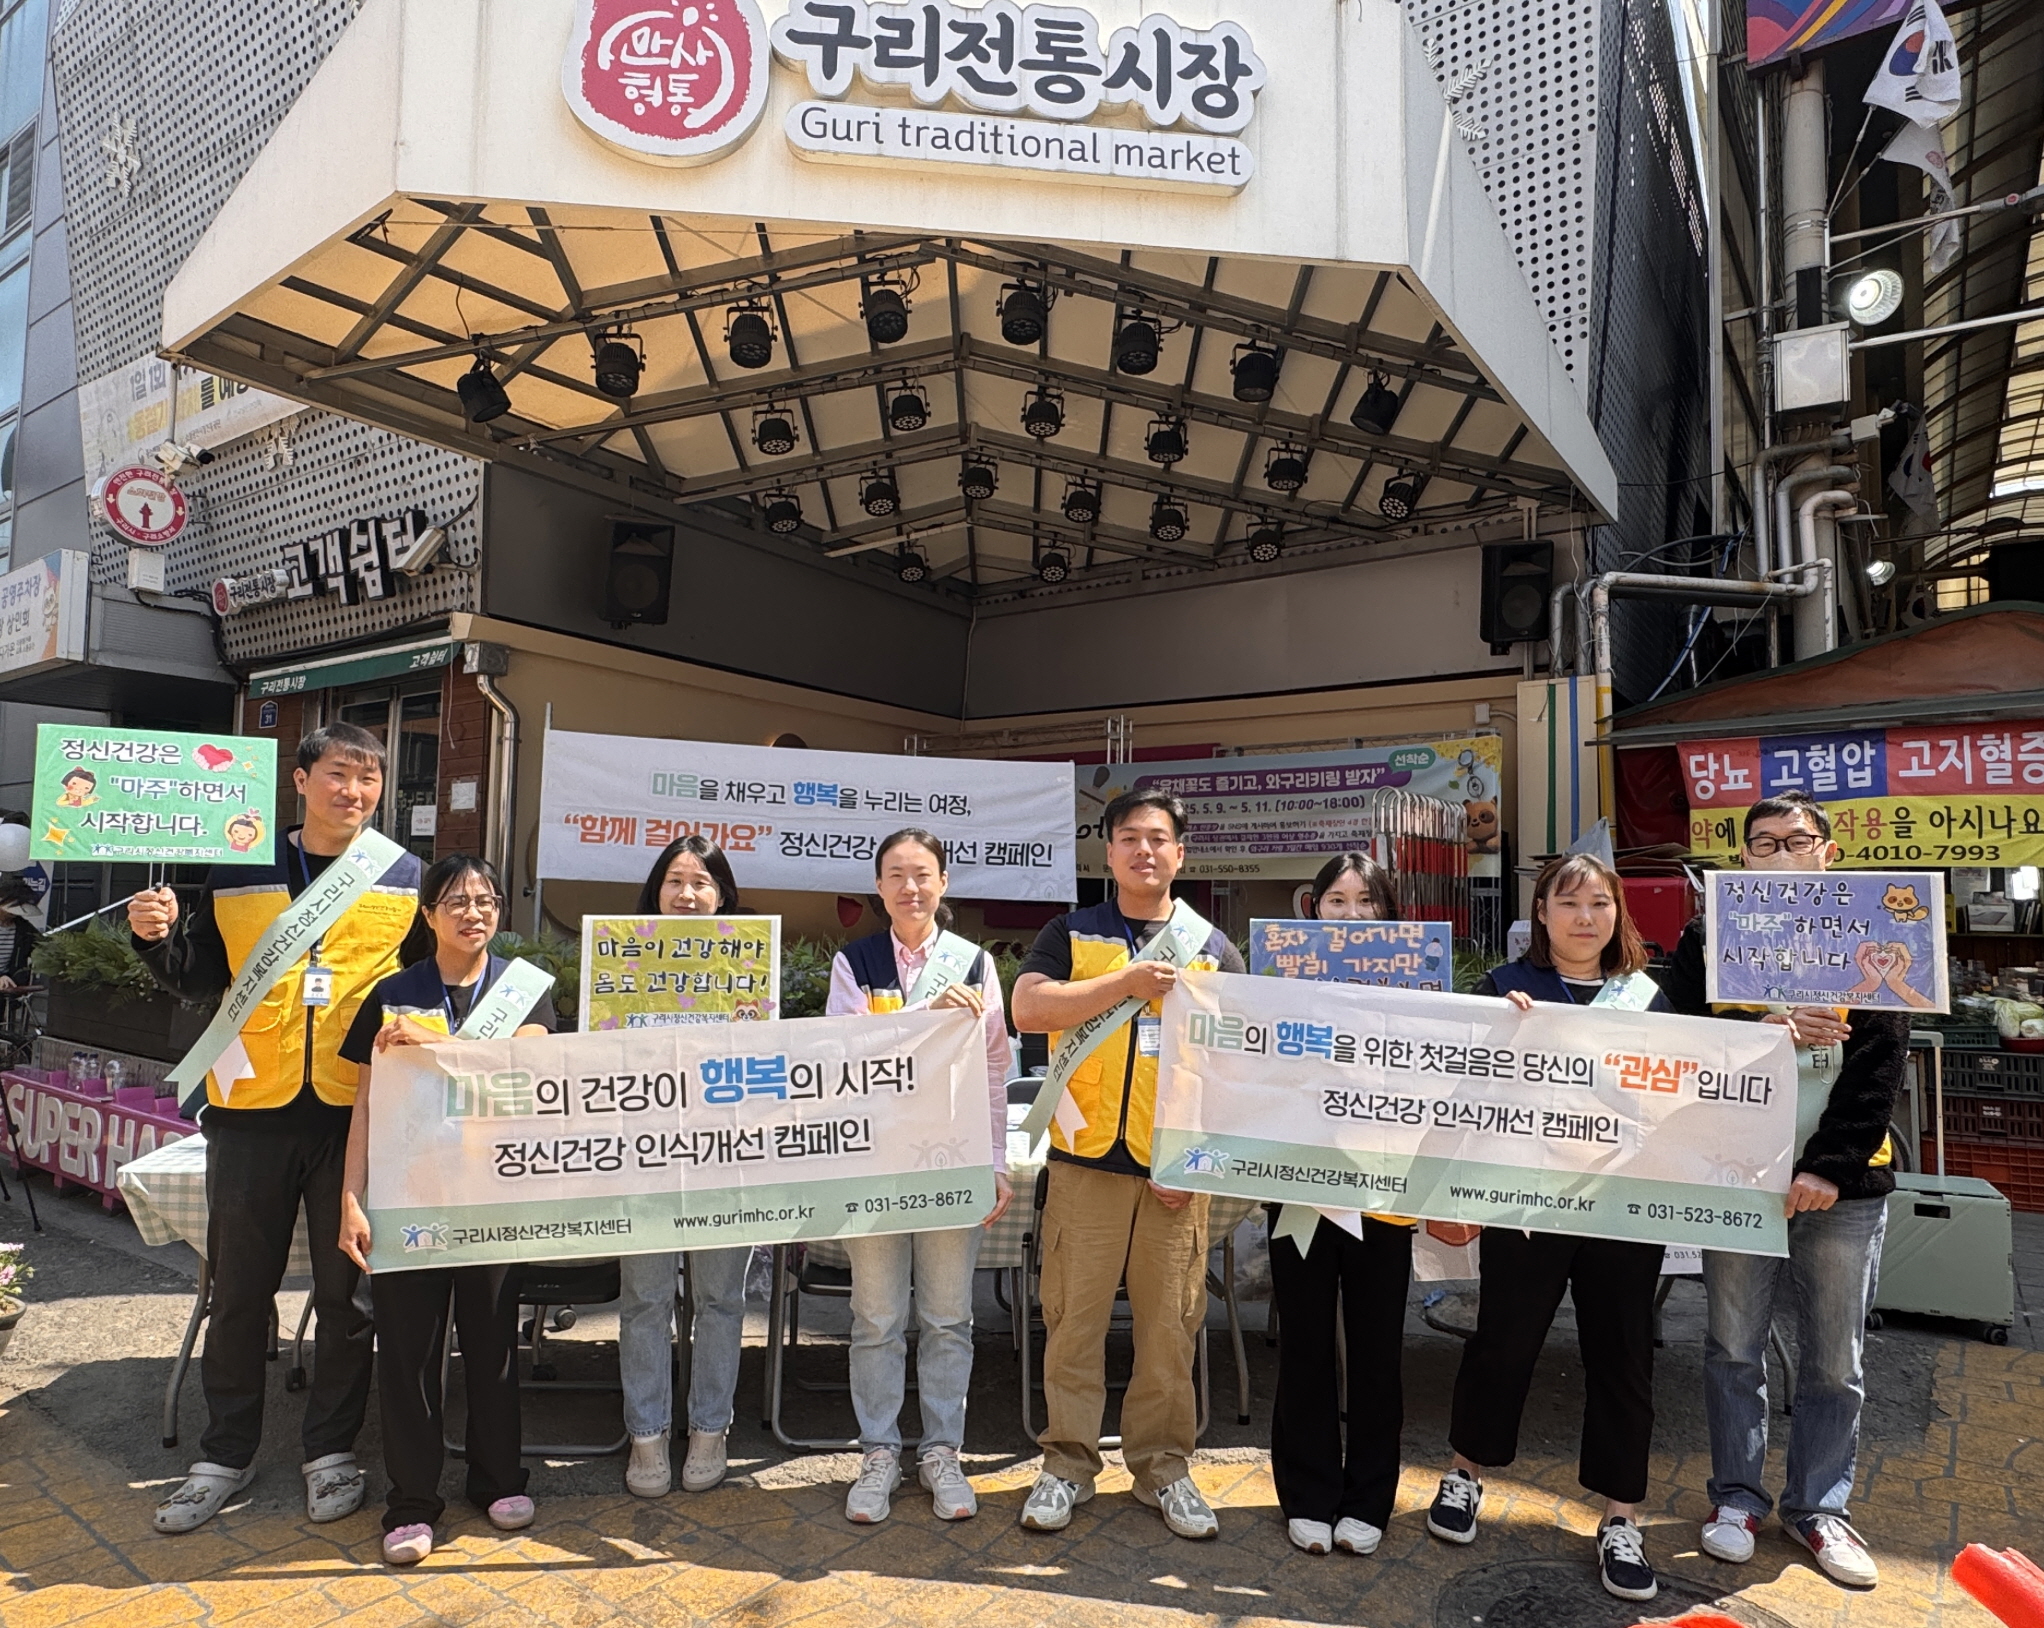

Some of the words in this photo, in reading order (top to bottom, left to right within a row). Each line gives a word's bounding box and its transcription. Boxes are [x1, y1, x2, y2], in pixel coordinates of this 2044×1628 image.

[620, 27, 714, 69] 만사
[785, 2, 1253, 119] 구리전통시장
[800, 107, 885, 146] Guri
[898, 117, 1100, 165] traditional
[1113, 141, 1242, 177] market
[230, 572, 276, 600] 구리전통시장
[283, 510, 418, 606] 고객쉼터
[260, 675, 306, 695] 구리전통시장
[409, 648, 449, 669] 고객쉼터
[61, 738, 182, 765] 정신건강은
[1394, 754, 1430, 767] 선착순
[1689, 752, 1752, 800] 당뇨
[1770, 740, 1876, 793] 고혈압
[1899, 731, 2044, 786] 고지혈증
[652, 772, 719, 801] 마음을
[724, 780, 786, 805] 채우고
[793, 781, 858, 810] 행복을
[864, 789, 923, 813] 누리는
[928, 793, 972, 817] 여정,
[1215, 775, 1263, 792] 즐기고,
[1266, 771, 1340, 790] 와구리키링
[1345, 767, 1385, 785] 받자”
[80, 812, 208, 836] 시작합니다.
[1202, 803, 1213, 814] 5.
[1216, 802, 1226, 814] 9.
[1241, 801, 1251, 813] 5.
[1255, 801, 1271, 812] 11.
[1691, 817, 1737, 850] 약에
[1833, 806, 1917, 842] 작용을
[1929, 804, 2044, 840] 아시나요
[564, 813, 637, 846] “함께
[779, 831, 877, 861] 정신건강
[985, 841, 1052, 868] 캠페인
[1199, 864, 1260, 874] 031-550-8355
[1724, 881, 1854, 906] 정신건강은
[227, 871, 355, 1023] 구리시정신건강복지센터
[598, 936, 664, 959] 마음이
[671, 936, 765, 960] 건강해야
[1265, 924, 1308, 952] 혼자
[1322, 924, 1424, 953] 걸어가면
[1723, 946, 1851, 972] 시작합니다
[594, 972, 638, 995] 몸도
[647, 970, 768, 995] 건강합니다!
[1343, 952, 1422, 976] 가지만
[1188, 1012, 1267, 1055] 마음의
[1276, 1020, 1356, 1064] 행복을
[1363, 1037, 1413, 1069] 위한
[1419, 1041, 1515, 1080] 첫걸음은
[1523, 1052, 1594, 1088] 당신의
[445, 1071, 570, 1119] 마음의
[582, 1070, 687, 1113] 건강이
[700, 1054, 823, 1106] 행복의
[834, 1055, 916, 1100] 시작!
[6, 1083, 101, 1184] SUPER
[1323, 1089, 1426, 1125] 정신건강
[1433, 1100, 1534, 1136] 인식개선
[1542, 1111, 1619, 1144] 캠페인
[494, 1137, 626, 1179] 정신건강
[635, 1124, 765, 1168] 인식개선
[774, 1118, 872, 1160] 캠페인
[1231, 1159, 1407, 1195] 구리시정신건강복지센터
[673, 1203, 815, 1230] www.gurimhc.or.kr
[864, 1189, 974, 1213] 031-523-8672
[1450, 1184, 1596, 1213] www.gurimhc.or.kr
[1647, 1203, 1763, 1230] 031-523-8672
[452, 1218, 632, 1245] 구리시정신건강복지센터
